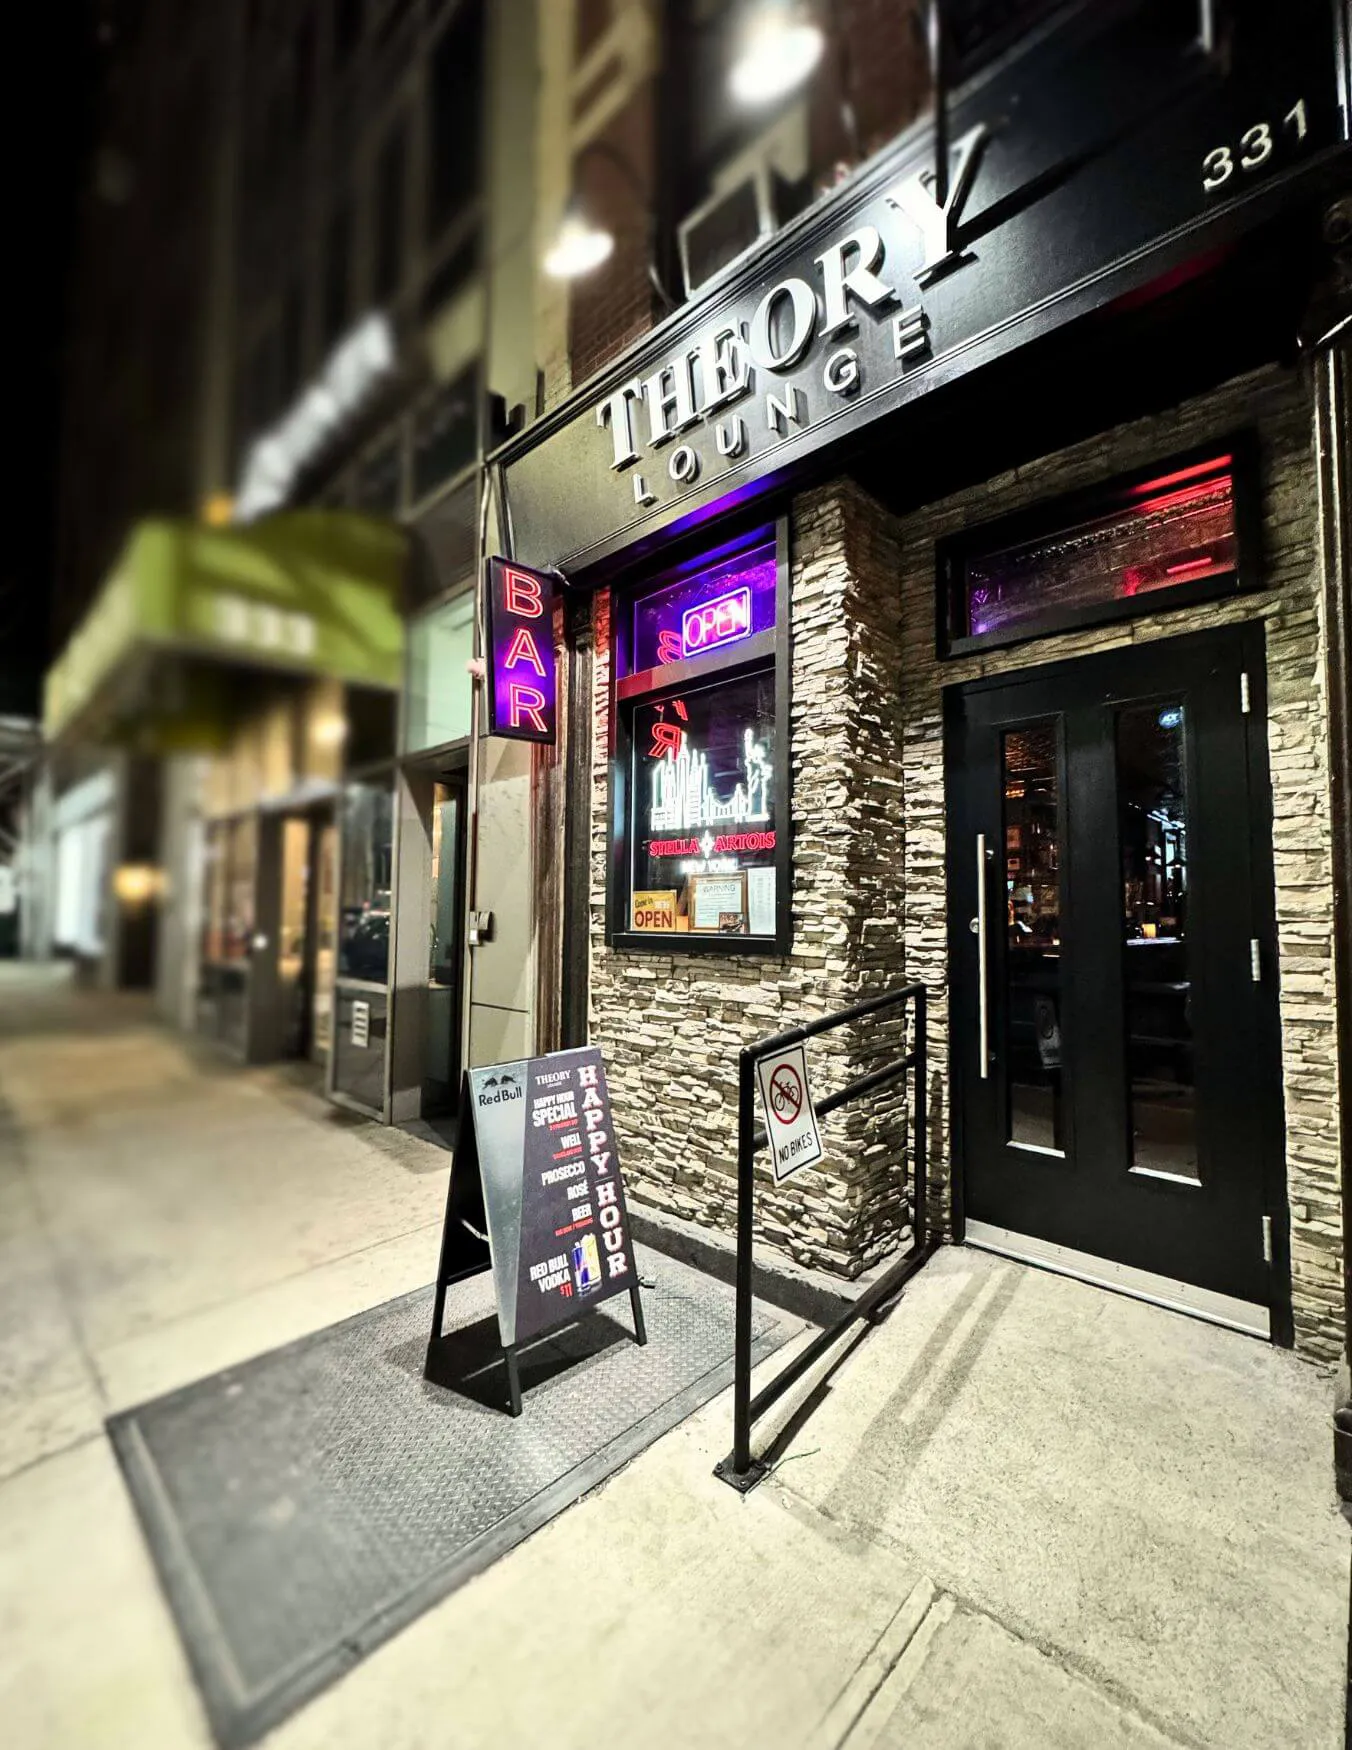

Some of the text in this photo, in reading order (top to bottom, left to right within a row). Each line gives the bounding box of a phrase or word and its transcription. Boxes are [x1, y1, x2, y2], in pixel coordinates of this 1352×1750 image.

[1202, 98, 1307, 193] 331
[595, 122, 987, 470] THEORY
[633, 303, 931, 506] LOUNGE
[686, 593, 748, 648] OPEN
[504, 567, 548, 733] BAR
[649, 831, 776, 857] STELLA ARTOIS
[634, 910, 673, 928] OPEN
[534, 1069, 571, 1085] THEORY
[479, 1085, 522, 1107] Red Bull
[532, 1101, 578, 1127] SPECIAL
[560, 1132, 582, 1149] WELL
[778, 1131, 813, 1165] NO BIKES
[541, 1160, 586, 1187] PROSECCO
[577, 1064, 628, 1279] HAPPY HOUR
[571, 1203, 593, 1222] BEER
[529, 1253, 569, 1281] RED BULL
[538, 1268, 571, 1293] VODKA
[560, 1282, 573, 1297] $11
